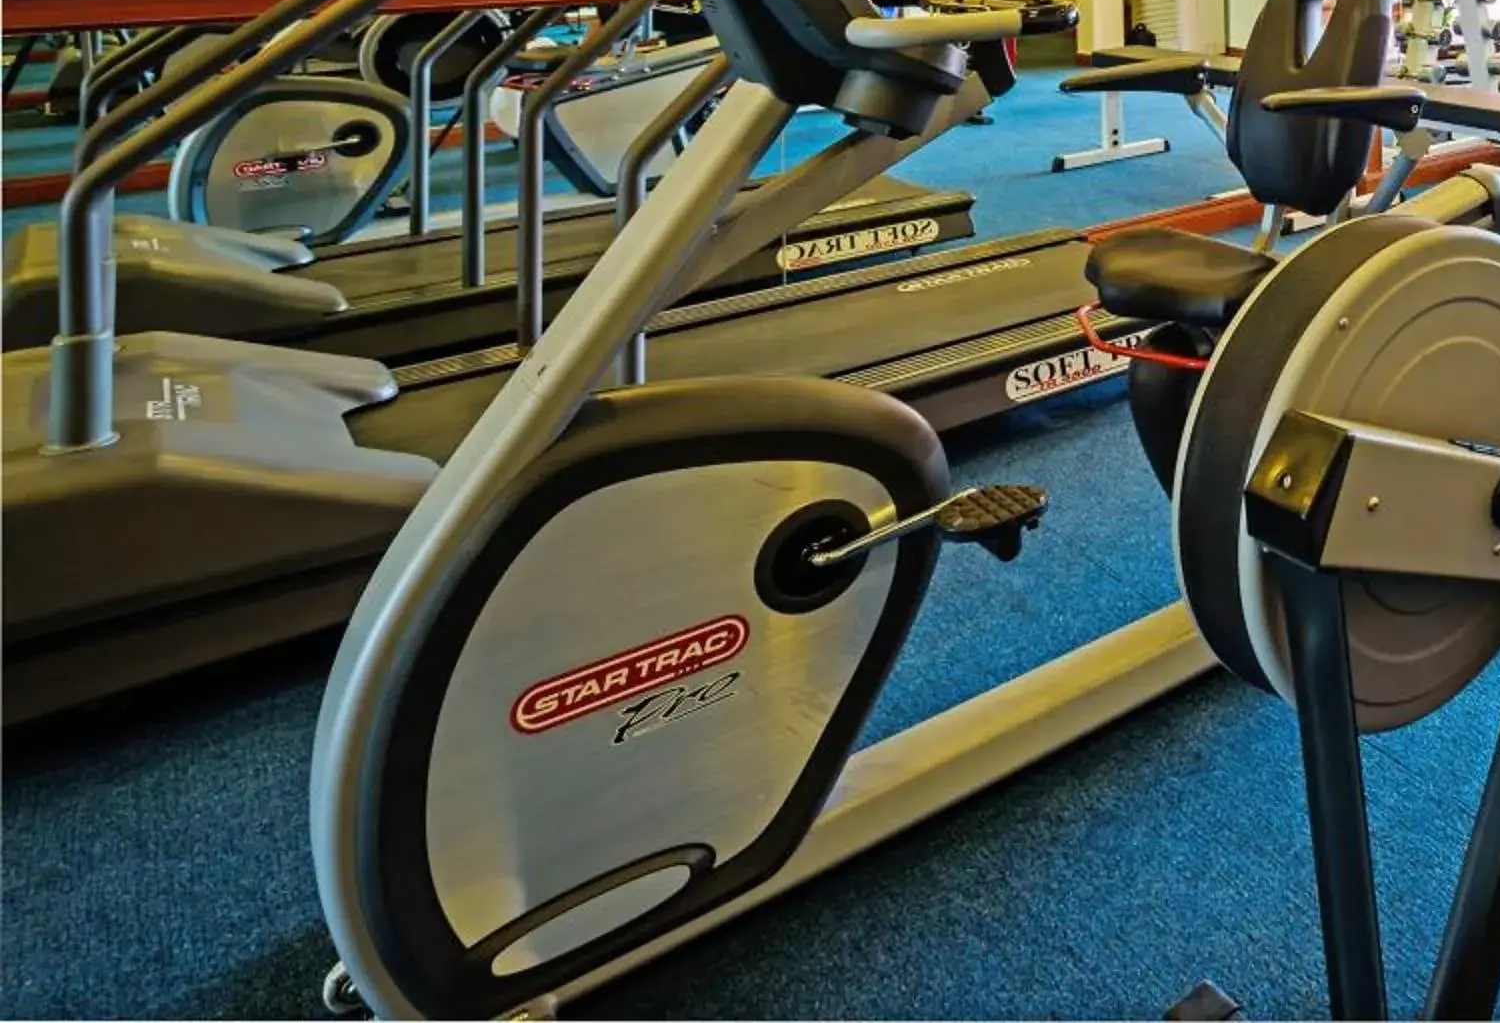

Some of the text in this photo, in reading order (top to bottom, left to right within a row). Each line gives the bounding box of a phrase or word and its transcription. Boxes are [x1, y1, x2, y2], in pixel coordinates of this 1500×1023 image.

[1013, 348, 1095, 392] SOFT
[534, 630, 730, 713] STAR TRAC
[613, 672, 740, 744] Pro
